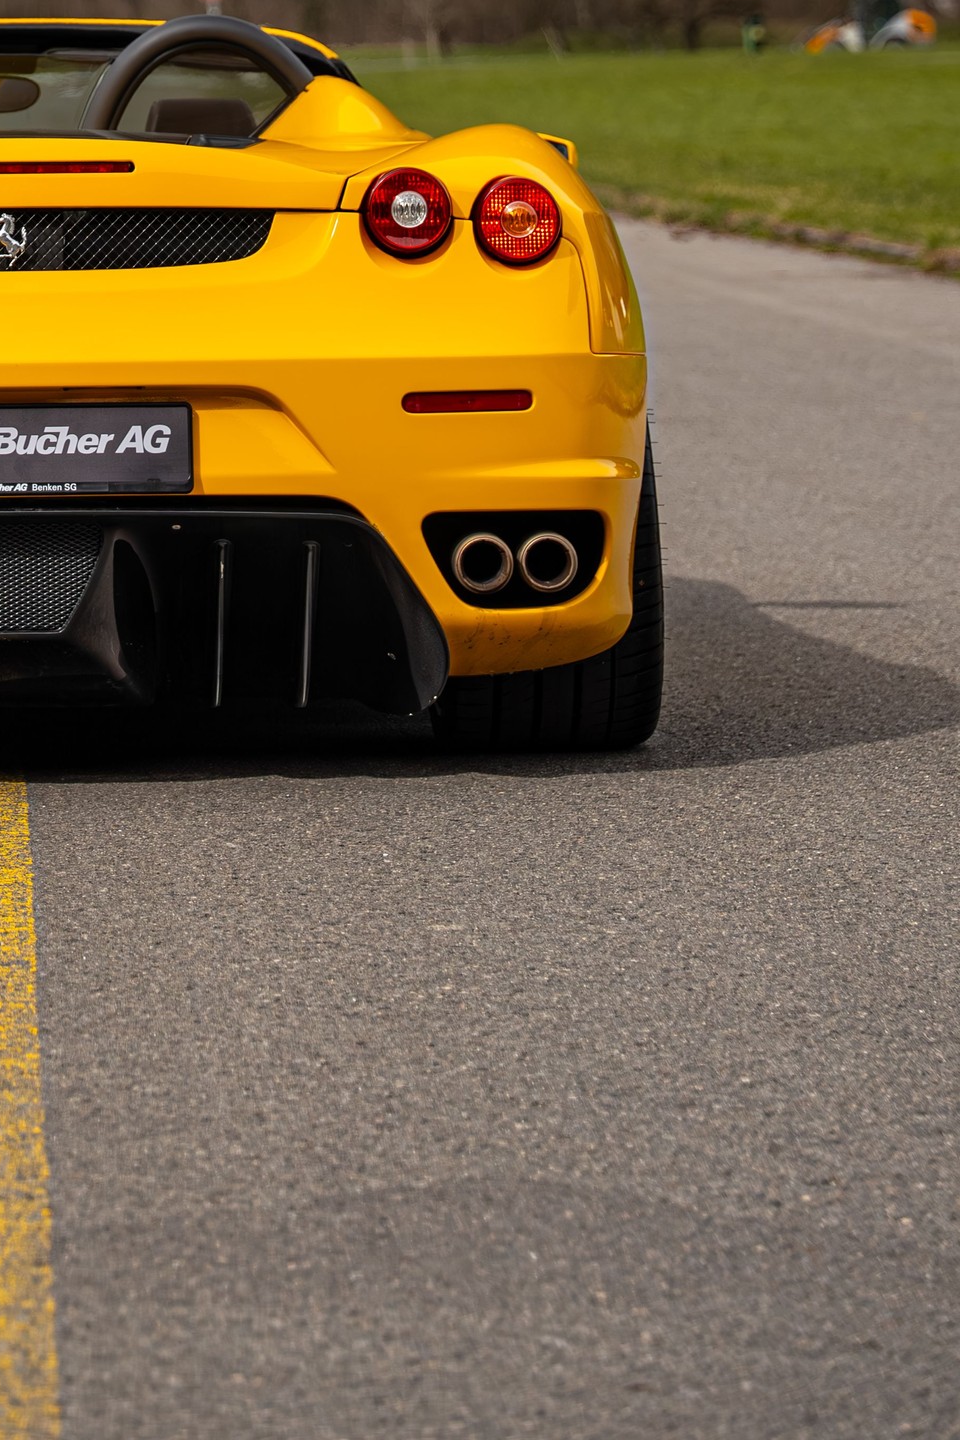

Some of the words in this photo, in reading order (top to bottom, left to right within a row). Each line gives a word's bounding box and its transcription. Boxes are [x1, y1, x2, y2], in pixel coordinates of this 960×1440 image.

[115, 424, 172, 454] AG
[14, 483, 28, 492] AG
[31, 483, 62, 492] Benken
[64, 482, 77, 492] SG
